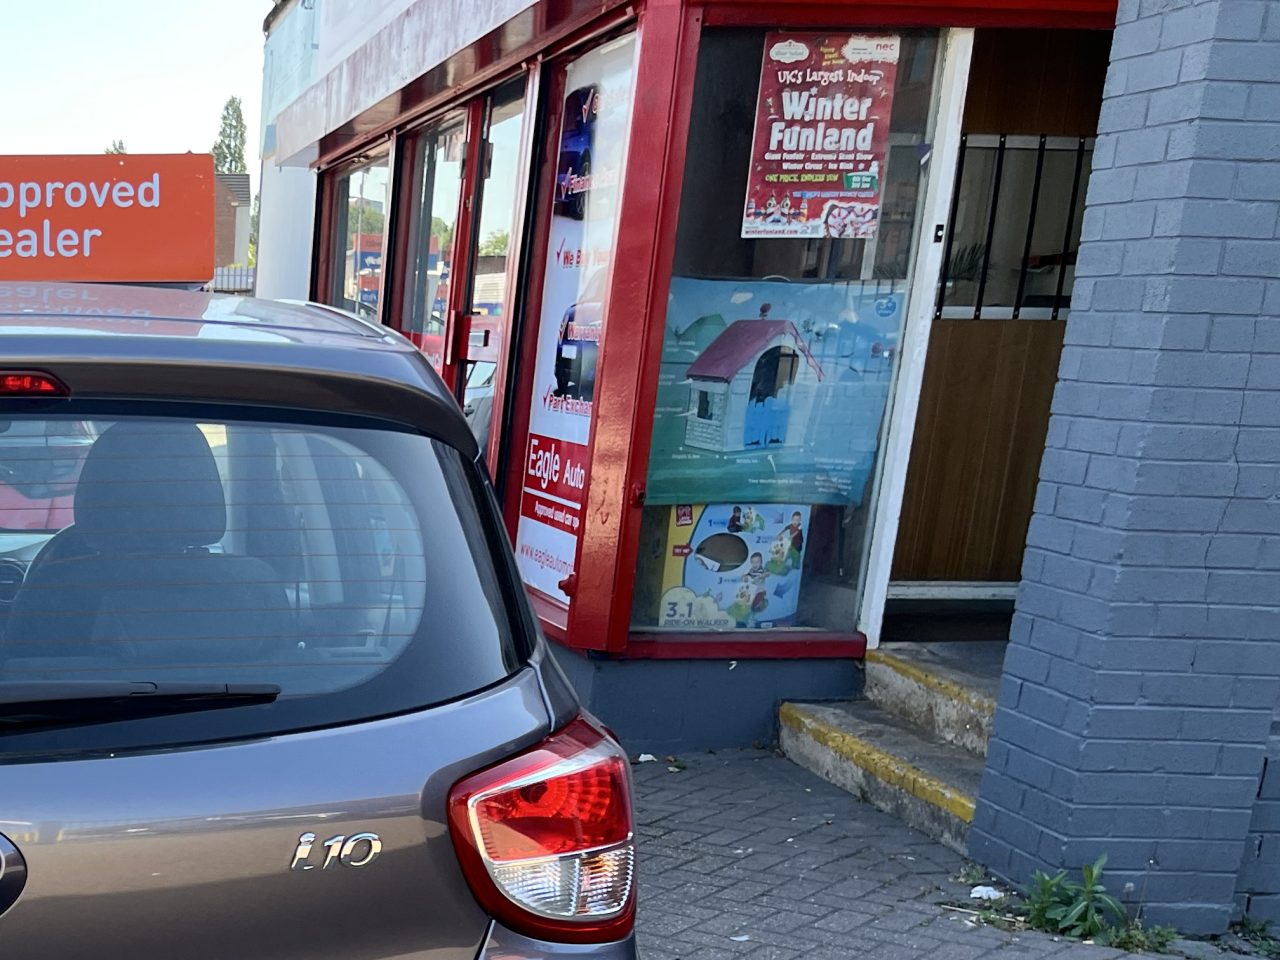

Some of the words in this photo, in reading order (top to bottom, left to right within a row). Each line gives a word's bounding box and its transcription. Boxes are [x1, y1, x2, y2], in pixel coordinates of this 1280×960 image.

[806, 68, 843, 85] Largest
[781, 87, 872, 121] Winter
[770, 121, 874, 151] Funland
[548, 393, 565, 412] Part
[528, 438, 560, 490] Eagle
[562, 458, 585, 490] Auto
[666, 602, 677, 617] 3
[686, 602, 693, 617] 1
[696, 618, 729, 627] WALKER
[291, 832, 382, 870] i10
